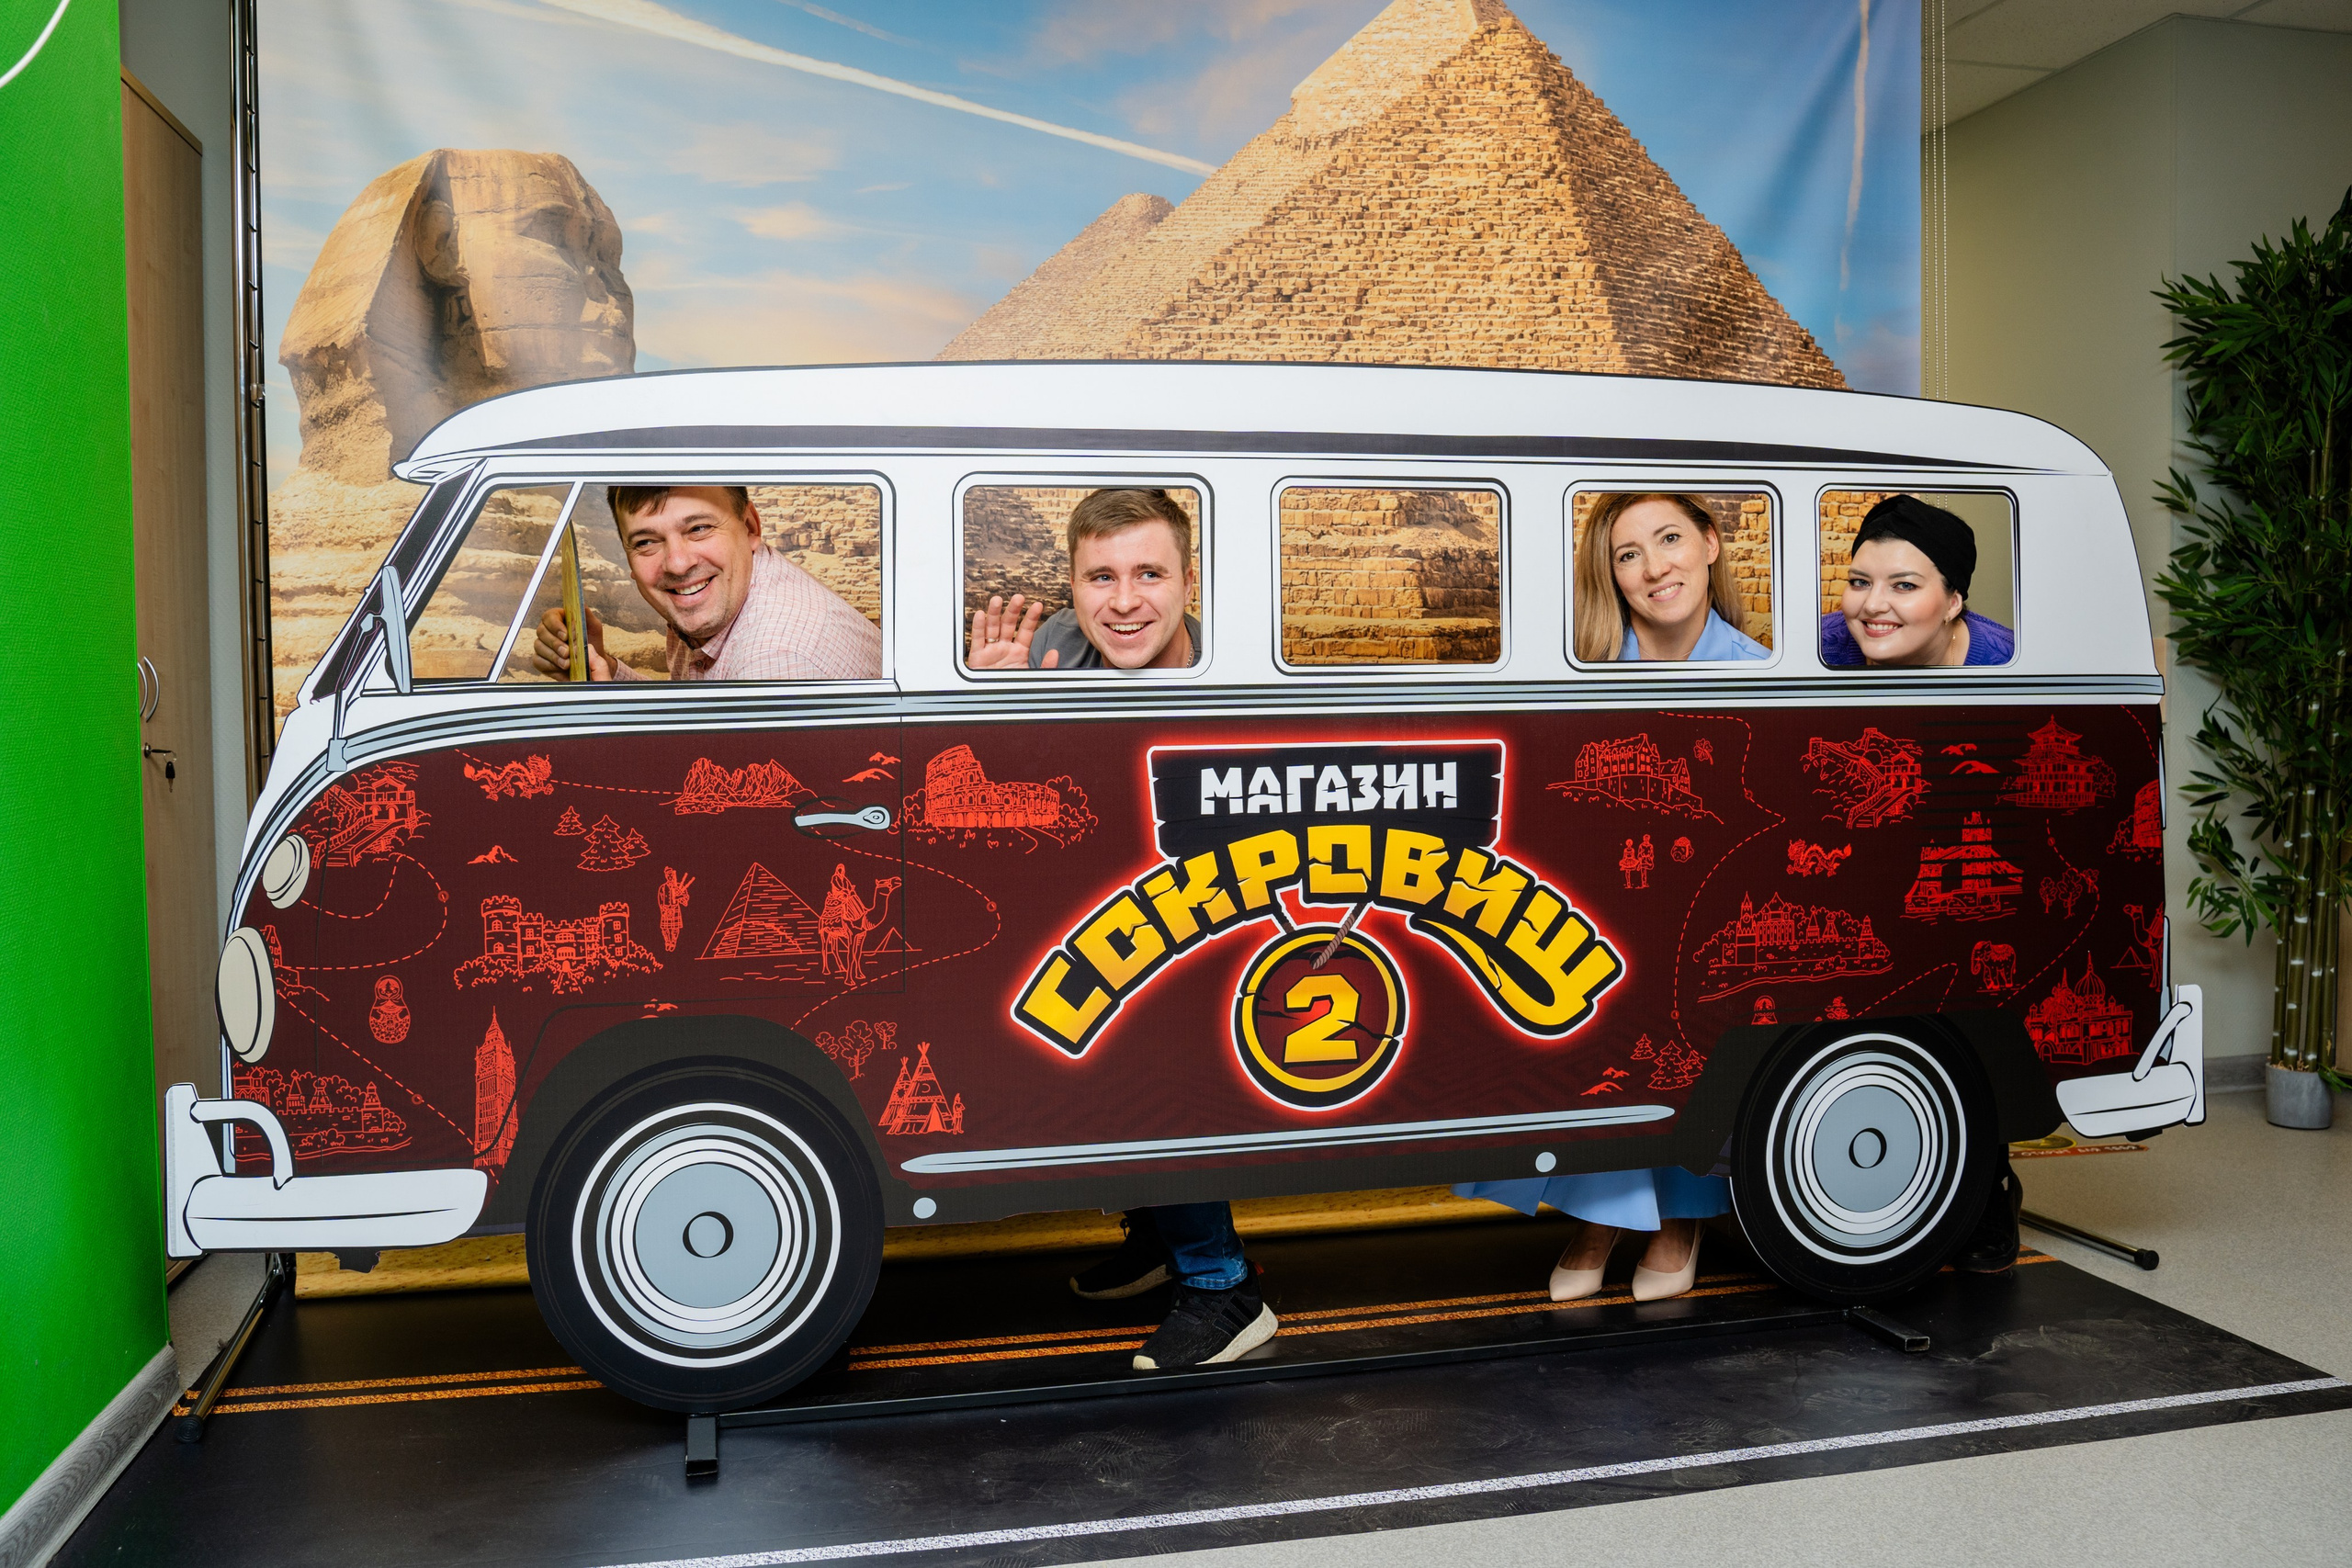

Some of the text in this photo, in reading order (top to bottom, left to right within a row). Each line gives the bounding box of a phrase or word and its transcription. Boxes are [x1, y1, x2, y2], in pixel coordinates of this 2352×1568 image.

[1200, 761, 1458, 816] МАГАЗИН
[1022, 824, 1620, 1045] СОКРОВИЩ
[1283, 974, 1360, 1063] 2
